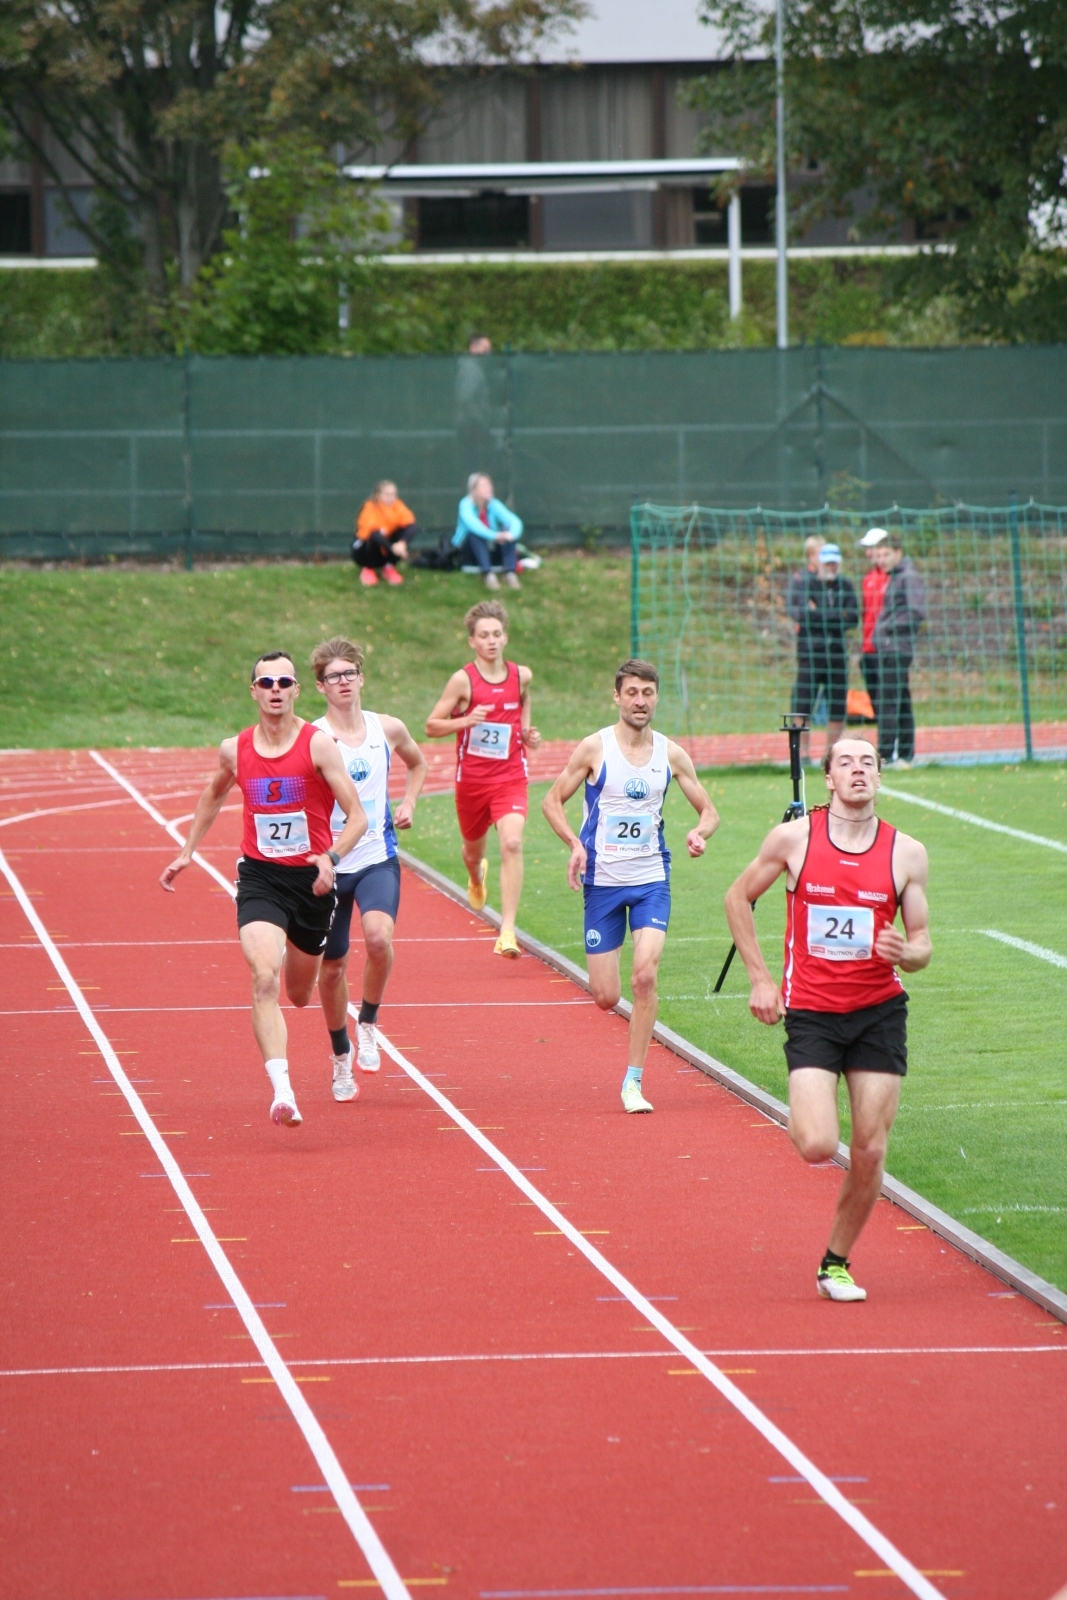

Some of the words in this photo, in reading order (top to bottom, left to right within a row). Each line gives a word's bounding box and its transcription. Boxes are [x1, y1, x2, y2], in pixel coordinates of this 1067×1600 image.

[481, 729, 500, 745] 23
[269, 822, 292, 841] 27
[617, 821, 641, 839] 26
[824, 917, 855, 940] 24
